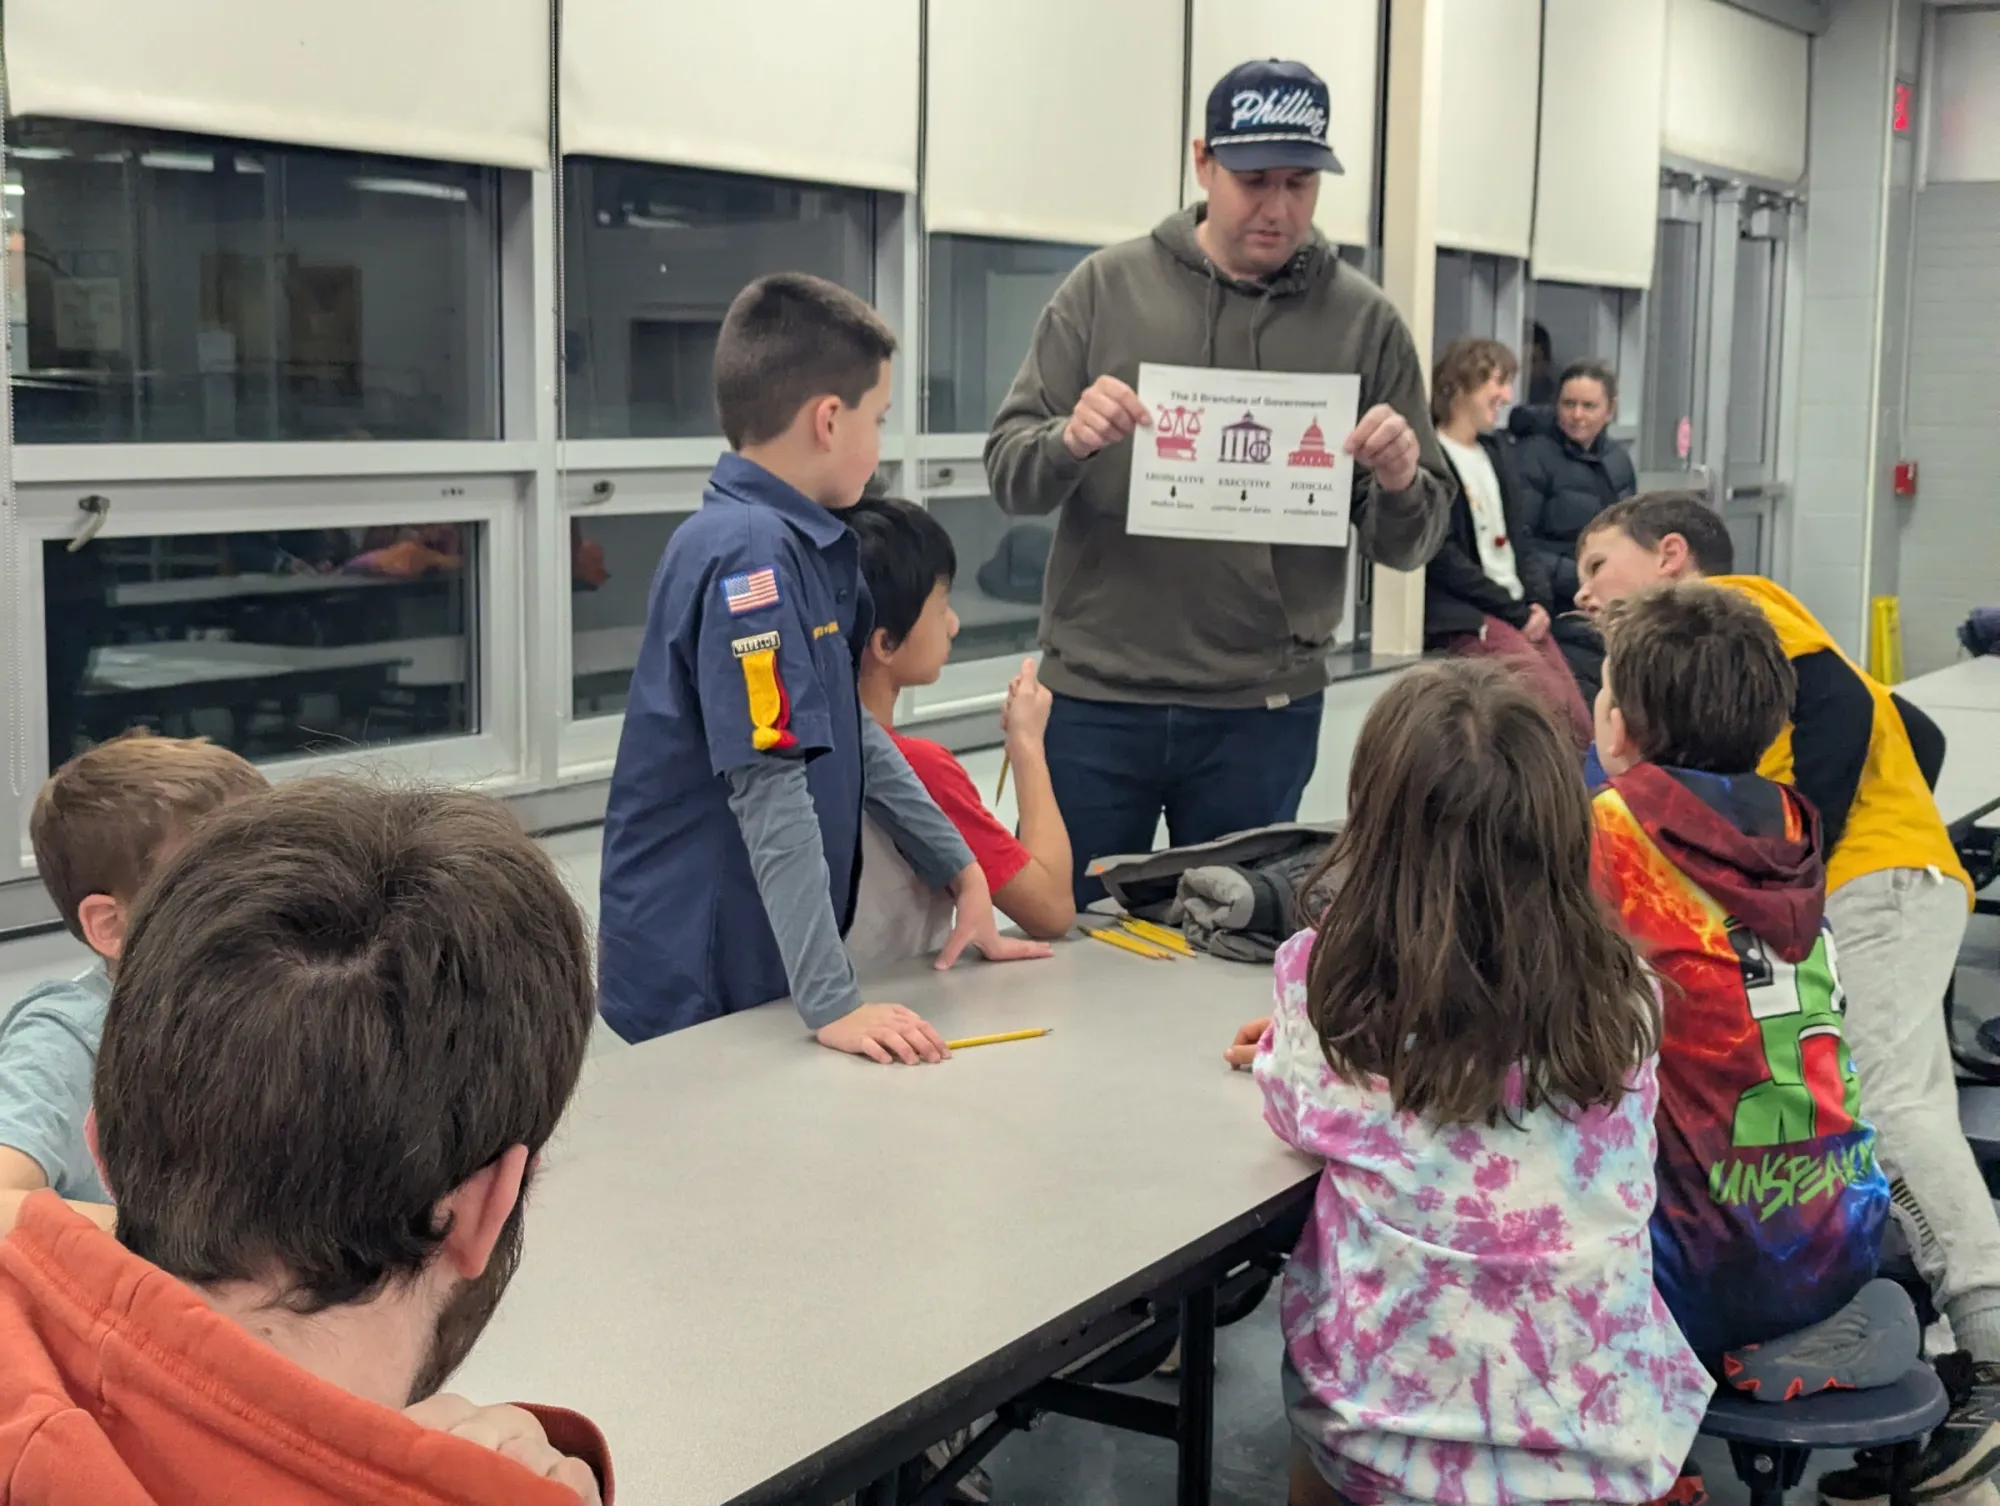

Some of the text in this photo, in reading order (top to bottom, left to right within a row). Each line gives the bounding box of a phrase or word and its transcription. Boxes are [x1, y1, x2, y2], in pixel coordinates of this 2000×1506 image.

[1231, 88, 1327, 137] Phillies
[1171, 391, 1328, 408] The 3 Branches of Government
[1145, 471, 1204, 484] LEGISLATIVE
[1218, 477, 1271, 488] EXECUTIVE
[1290, 481, 1333, 491] JUDICIAL
